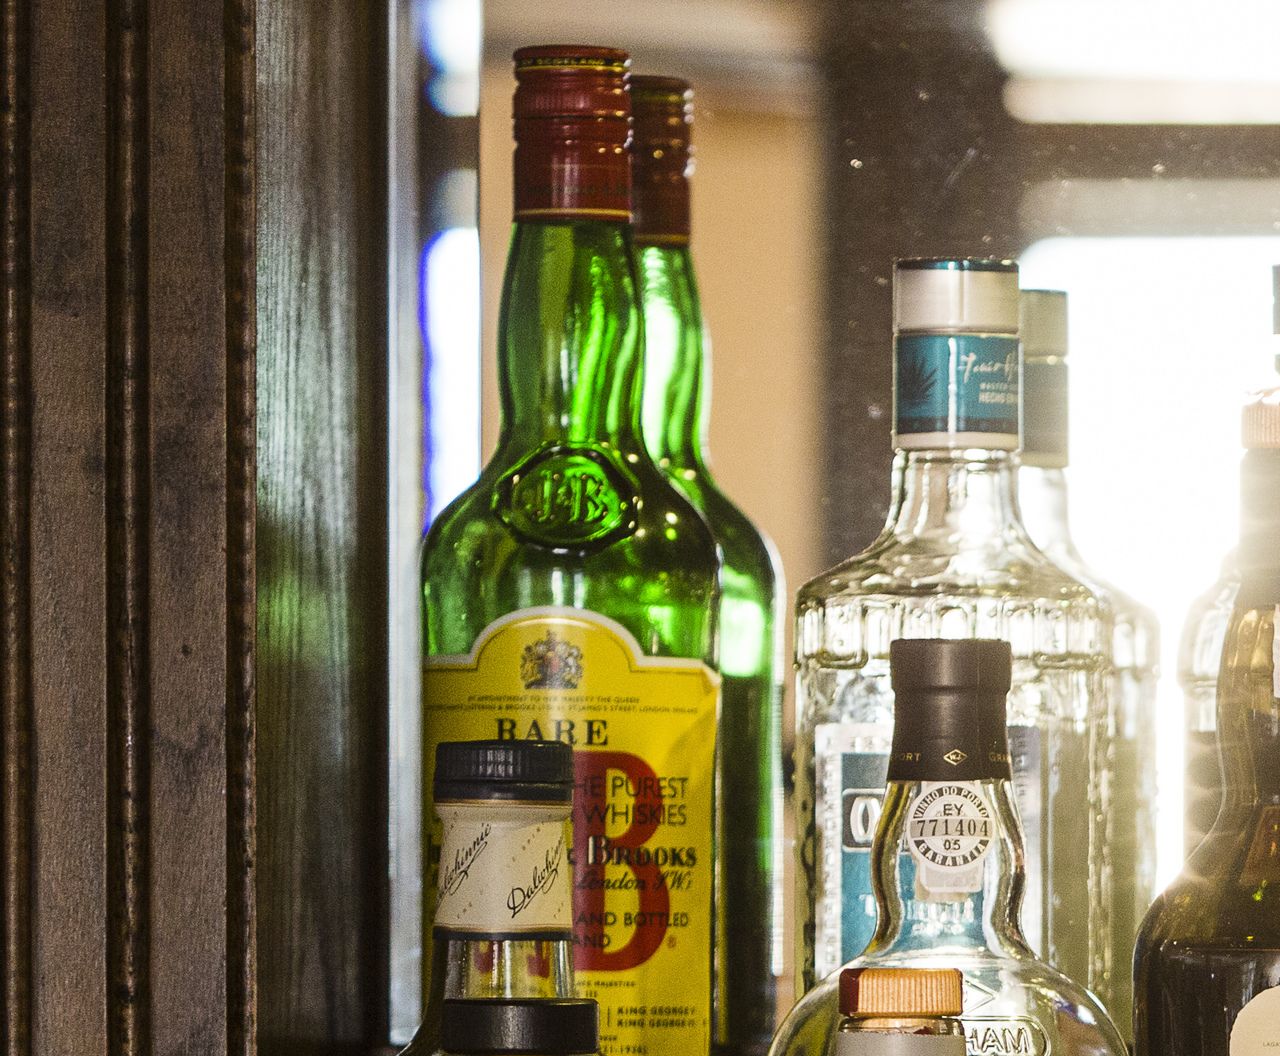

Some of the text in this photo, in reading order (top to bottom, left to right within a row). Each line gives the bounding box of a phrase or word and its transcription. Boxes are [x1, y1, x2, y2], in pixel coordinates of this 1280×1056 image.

[496, 718, 608, 746] RARE
[611, 778, 688, 799] PUREST
[913, 787, 988, 819] VINHO DO PORTO
[944, 804, 963, 816] EY
[917, 820, 988, 836] 771404
[587, 834, 697, 865] BROOKS
[918, 843, 986, 866] GARANTIA
[623, 912, 689, 927] BOTTLED
